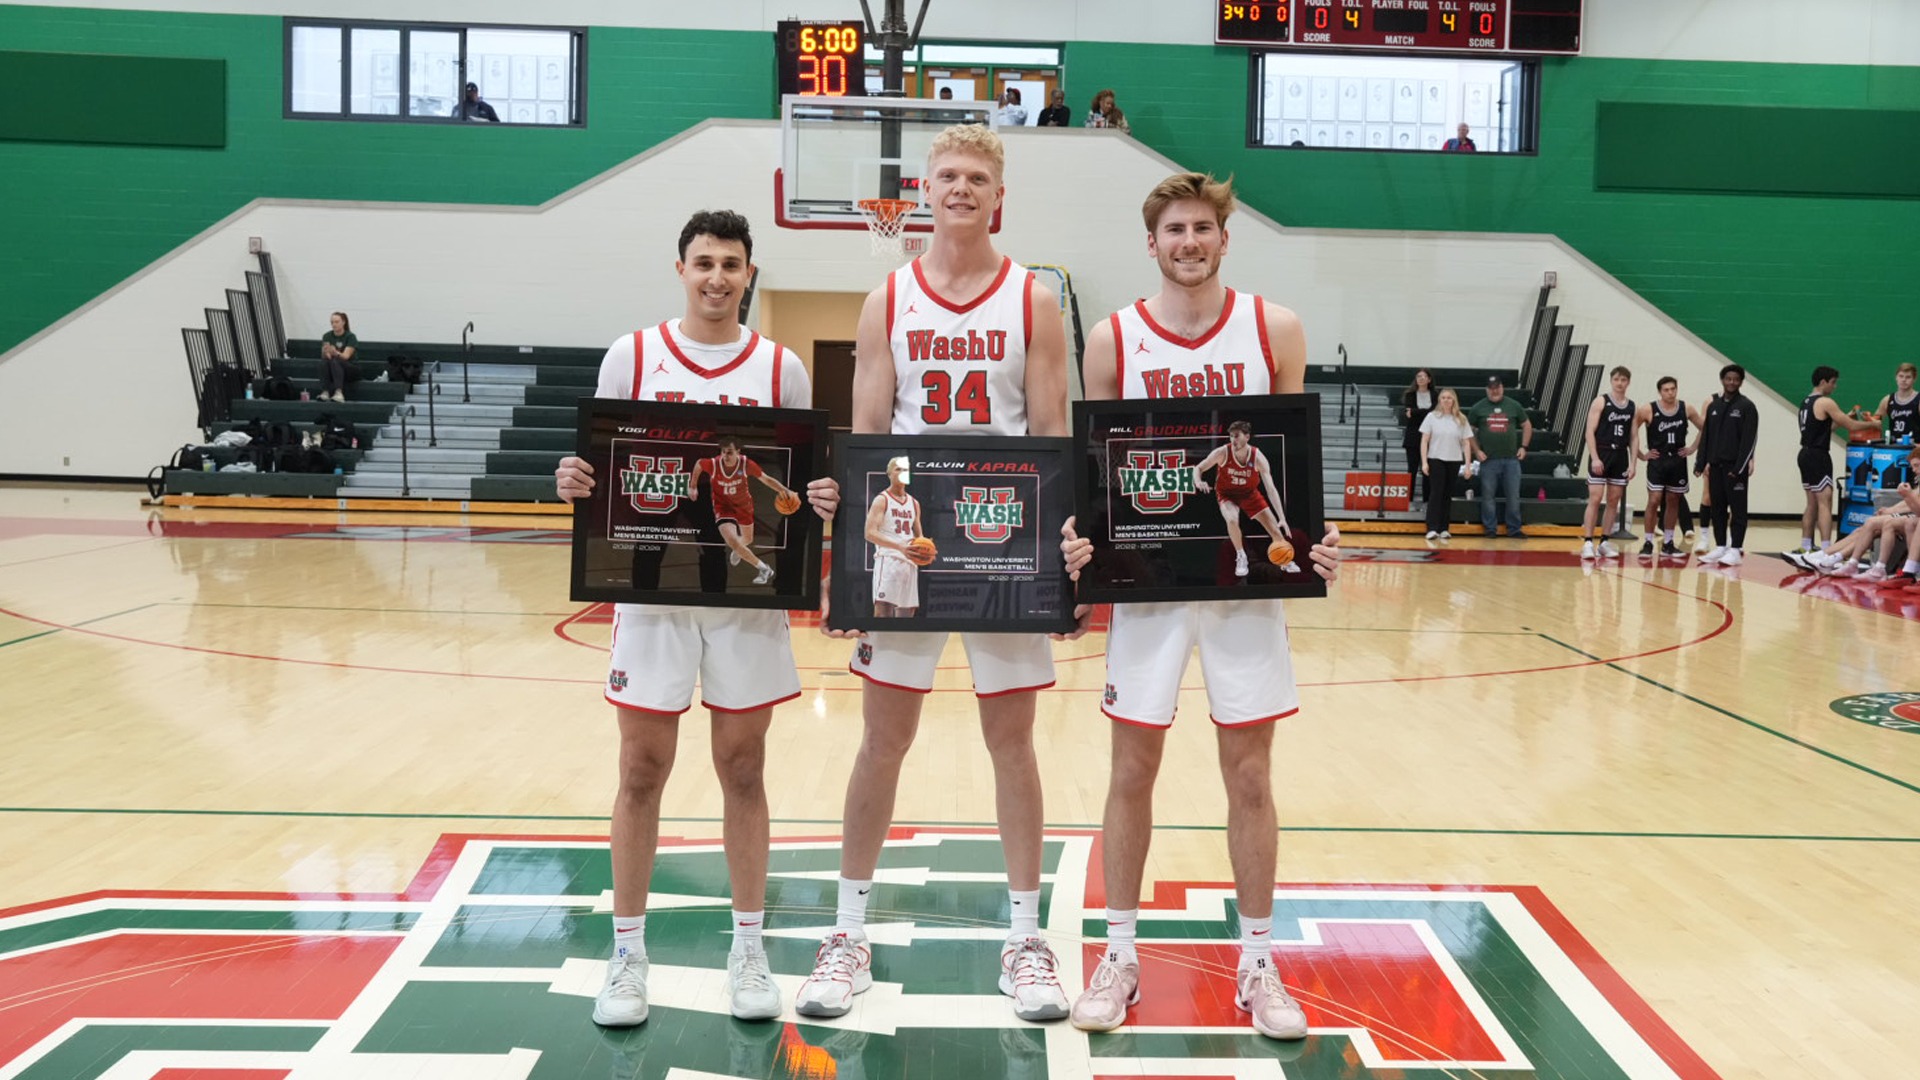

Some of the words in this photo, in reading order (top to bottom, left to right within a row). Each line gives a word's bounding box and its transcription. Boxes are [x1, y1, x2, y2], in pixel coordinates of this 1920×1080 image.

[1224, 4, 1244, 20] 34
[1371, 0, 1404, 9] PLAYER
[1408, 1, 1429, 10] FOUL
[1438, 1, 1461, 11] T.O.L.
[1469, 2, 1496, 12] FOULS
[1315, 7, 1328, 29] 0
[1345, 10, 1359, 29] 4
[1442, 13, 1455, 32] 4
[1479, 13, 1492, 35] 0
[801, 27, 857, 53] 6:00
[1303, 33, 1331, 42] SCORE
[1384, 35, 1415, 45] MATCH
[1468, 38, 1496, 48] SCORE
[799, 54, 846, 97] 30
[905, 238, 924, 251] EXIT
[906, 329, 1008, 362] WashU
[1141, 362, 1246, 399] WashU
[920, 369, 991, 425] 34
[617, 426, 648, 434] YOGI
[648, 428, 716, 441] OLIFF
[1613, 424, 1624, 436] 15
[1667, 432, 1676, 444] 11
[915, 461, 966, 469] CALVIN
[966, 462, 1040, 473] KAPRAL
[620, 469, 691, 498] WASH
[1118, 466, 1196, 496] WASH
[1358, 485, 1408, 498] NOISE
[954, 500, 1024, 528] WASH
[614, 525, 660, 533] WASHINGTON
[661, 527, 702, 535] UNIVERSITY
[636, 533, 680, 541] BASKETBALL
